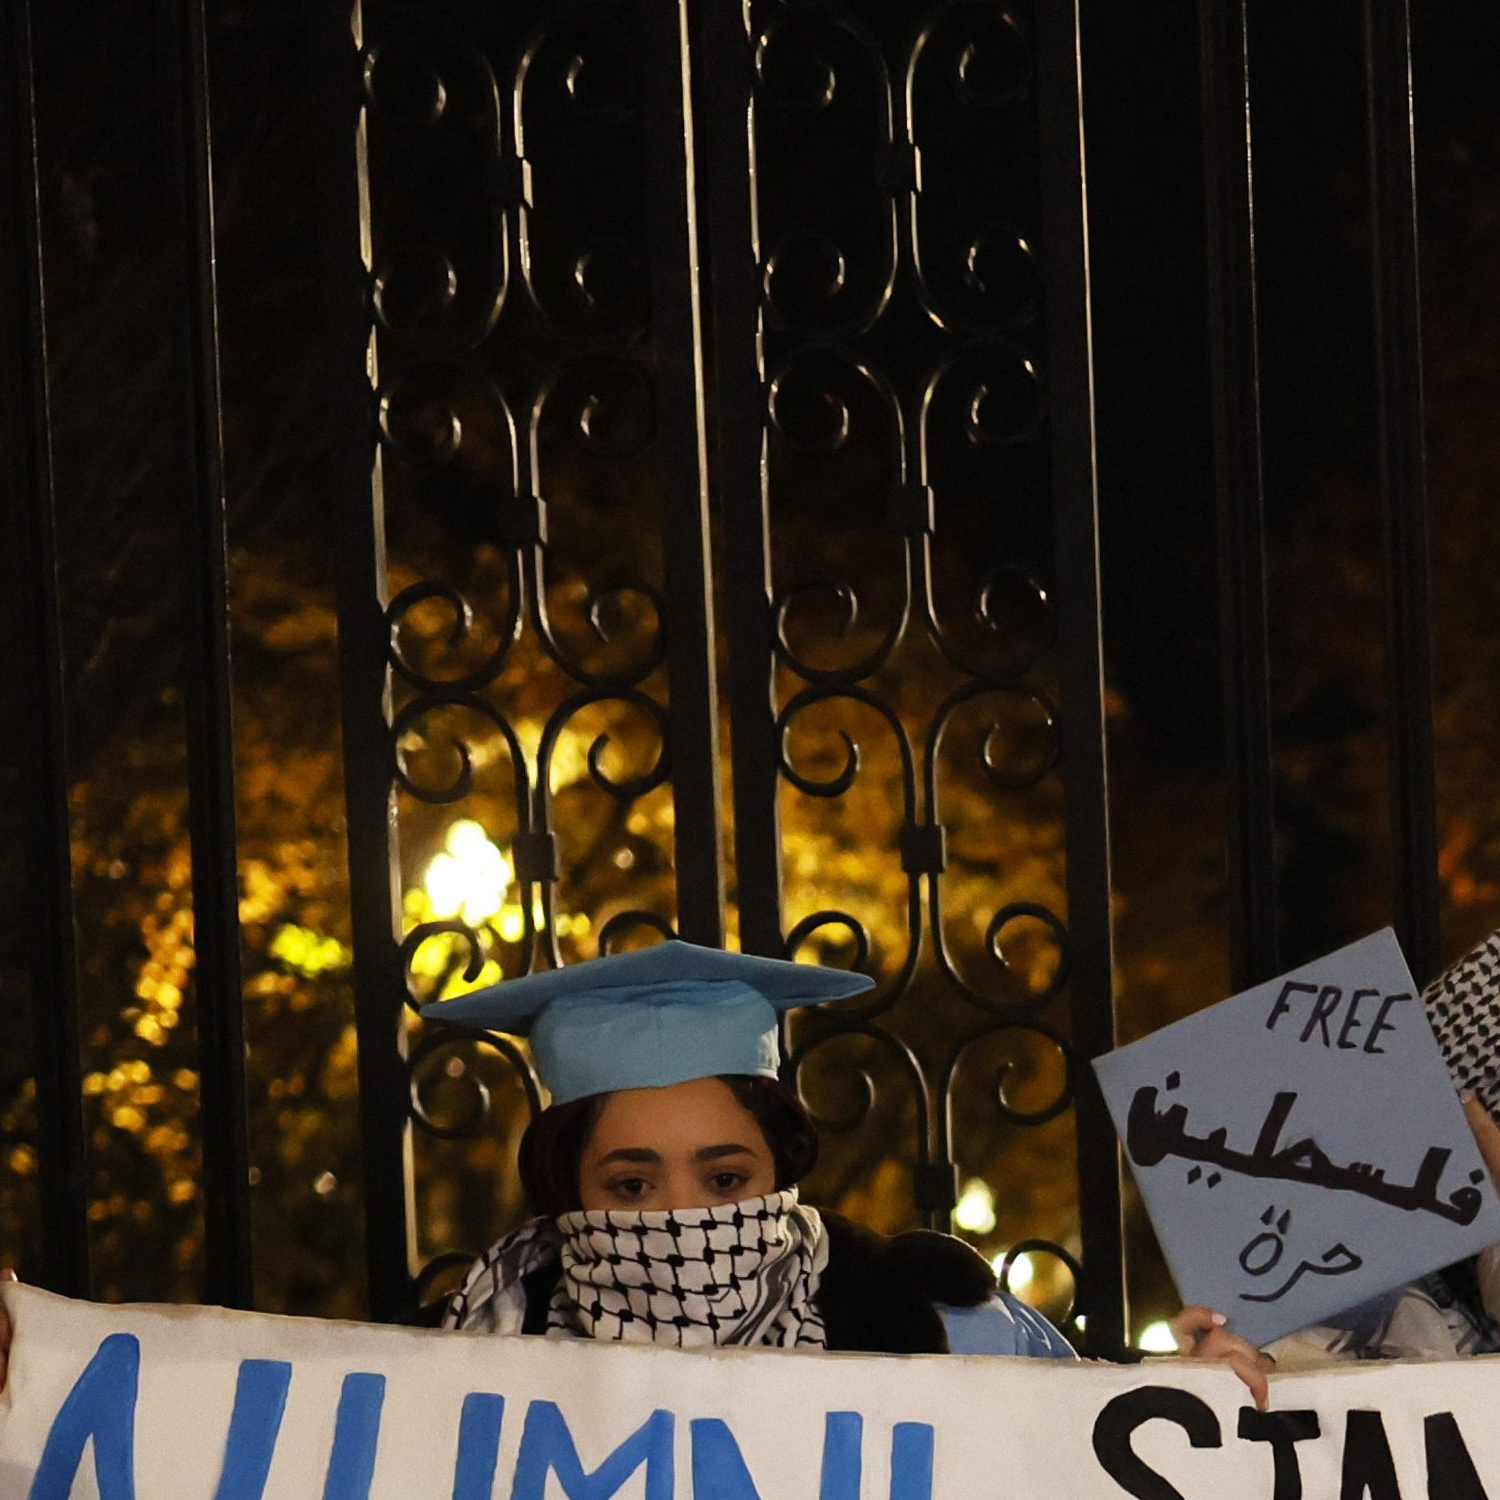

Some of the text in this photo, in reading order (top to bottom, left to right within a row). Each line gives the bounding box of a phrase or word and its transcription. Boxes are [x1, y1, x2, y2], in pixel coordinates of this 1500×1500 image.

[1266, 981, 1412, 1054] FREE
[1127, 1070, 1483, 1227] فلسطين
[1238, 1204, 1363, 1302] حرة
